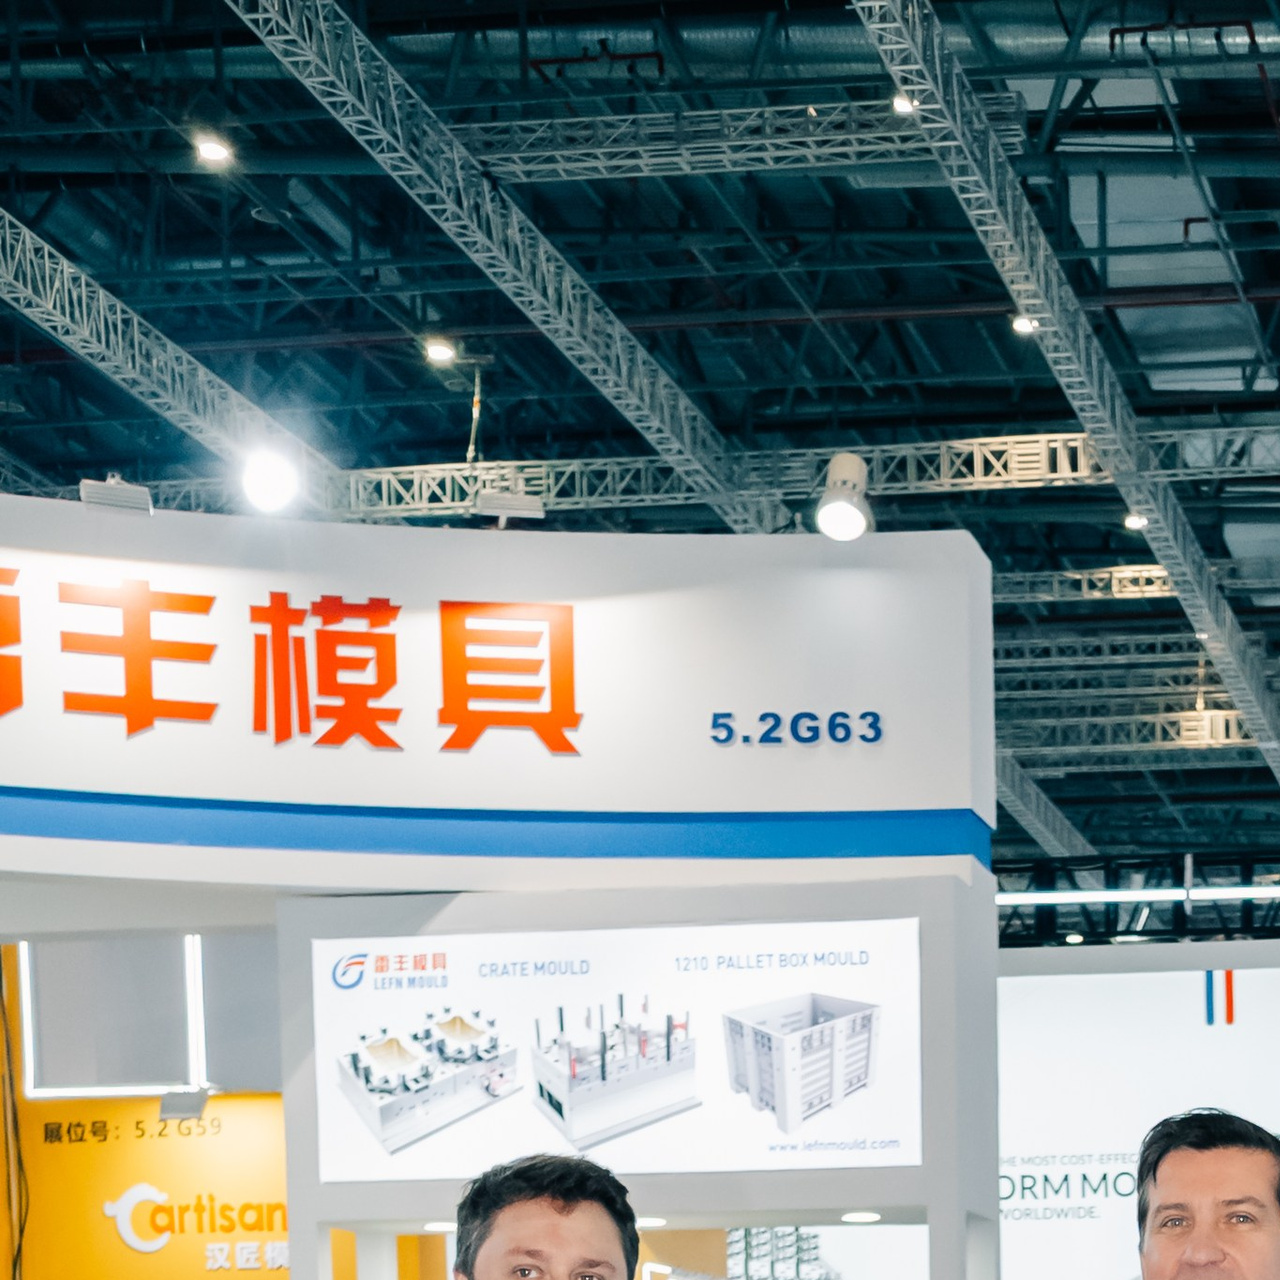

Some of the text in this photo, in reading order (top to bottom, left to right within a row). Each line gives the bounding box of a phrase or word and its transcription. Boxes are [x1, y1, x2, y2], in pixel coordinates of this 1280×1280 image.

[0, 567, 584, 756] 丰模具
[710, 711, 883, 744] 5.2G63
[478, 959, 590, 977] CRATE MOULD
[675, 950, 870, 972] 1210 PALLET BOX MOULD
[407, 974, 448, 989] MOULD
[1081, 1171, 1137, 1198] MO
